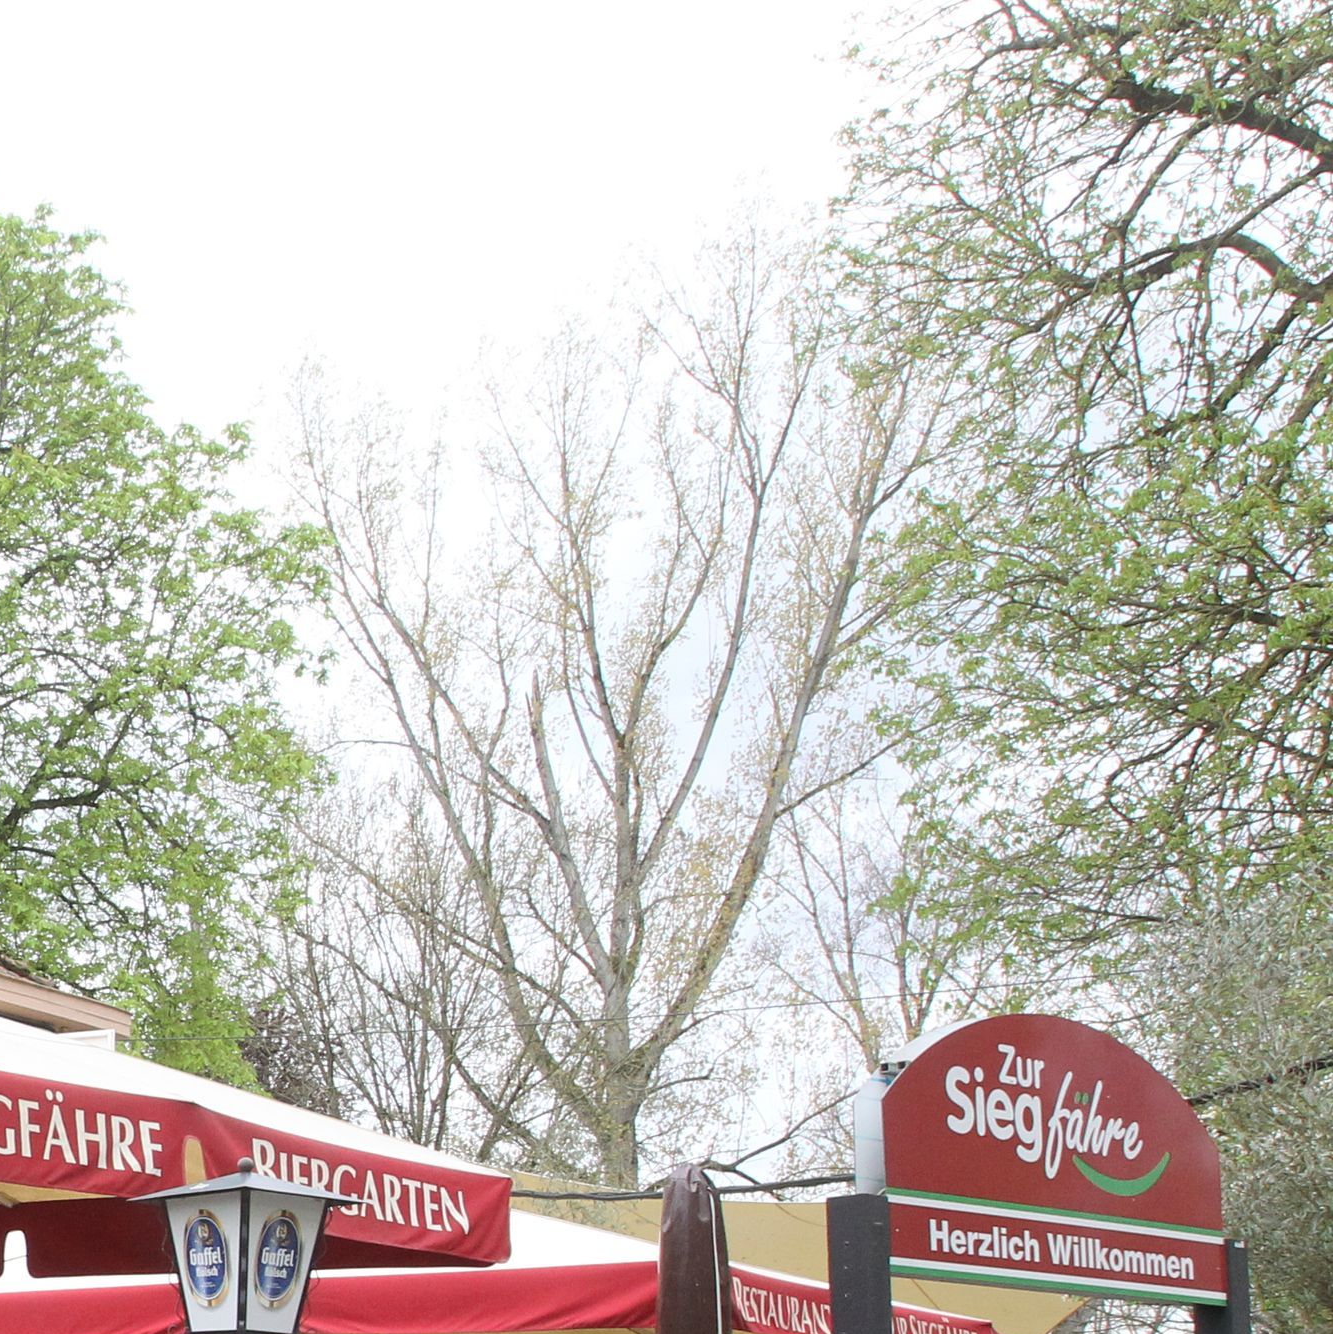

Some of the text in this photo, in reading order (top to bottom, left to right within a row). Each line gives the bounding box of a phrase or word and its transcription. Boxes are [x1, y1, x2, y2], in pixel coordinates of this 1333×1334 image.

[997, 1043, 1046, 1089] Zur
[944, 1064, 1144, 1180] Siegfähre
[251, 1137, 470, 1236] BIERGARTEN
[189, 1246, 223, 1267] Gaffel
[261, 1246, 295, 1268] Gaffel
[928, 1217, 1195, 1281] Herzlich Willkommen
